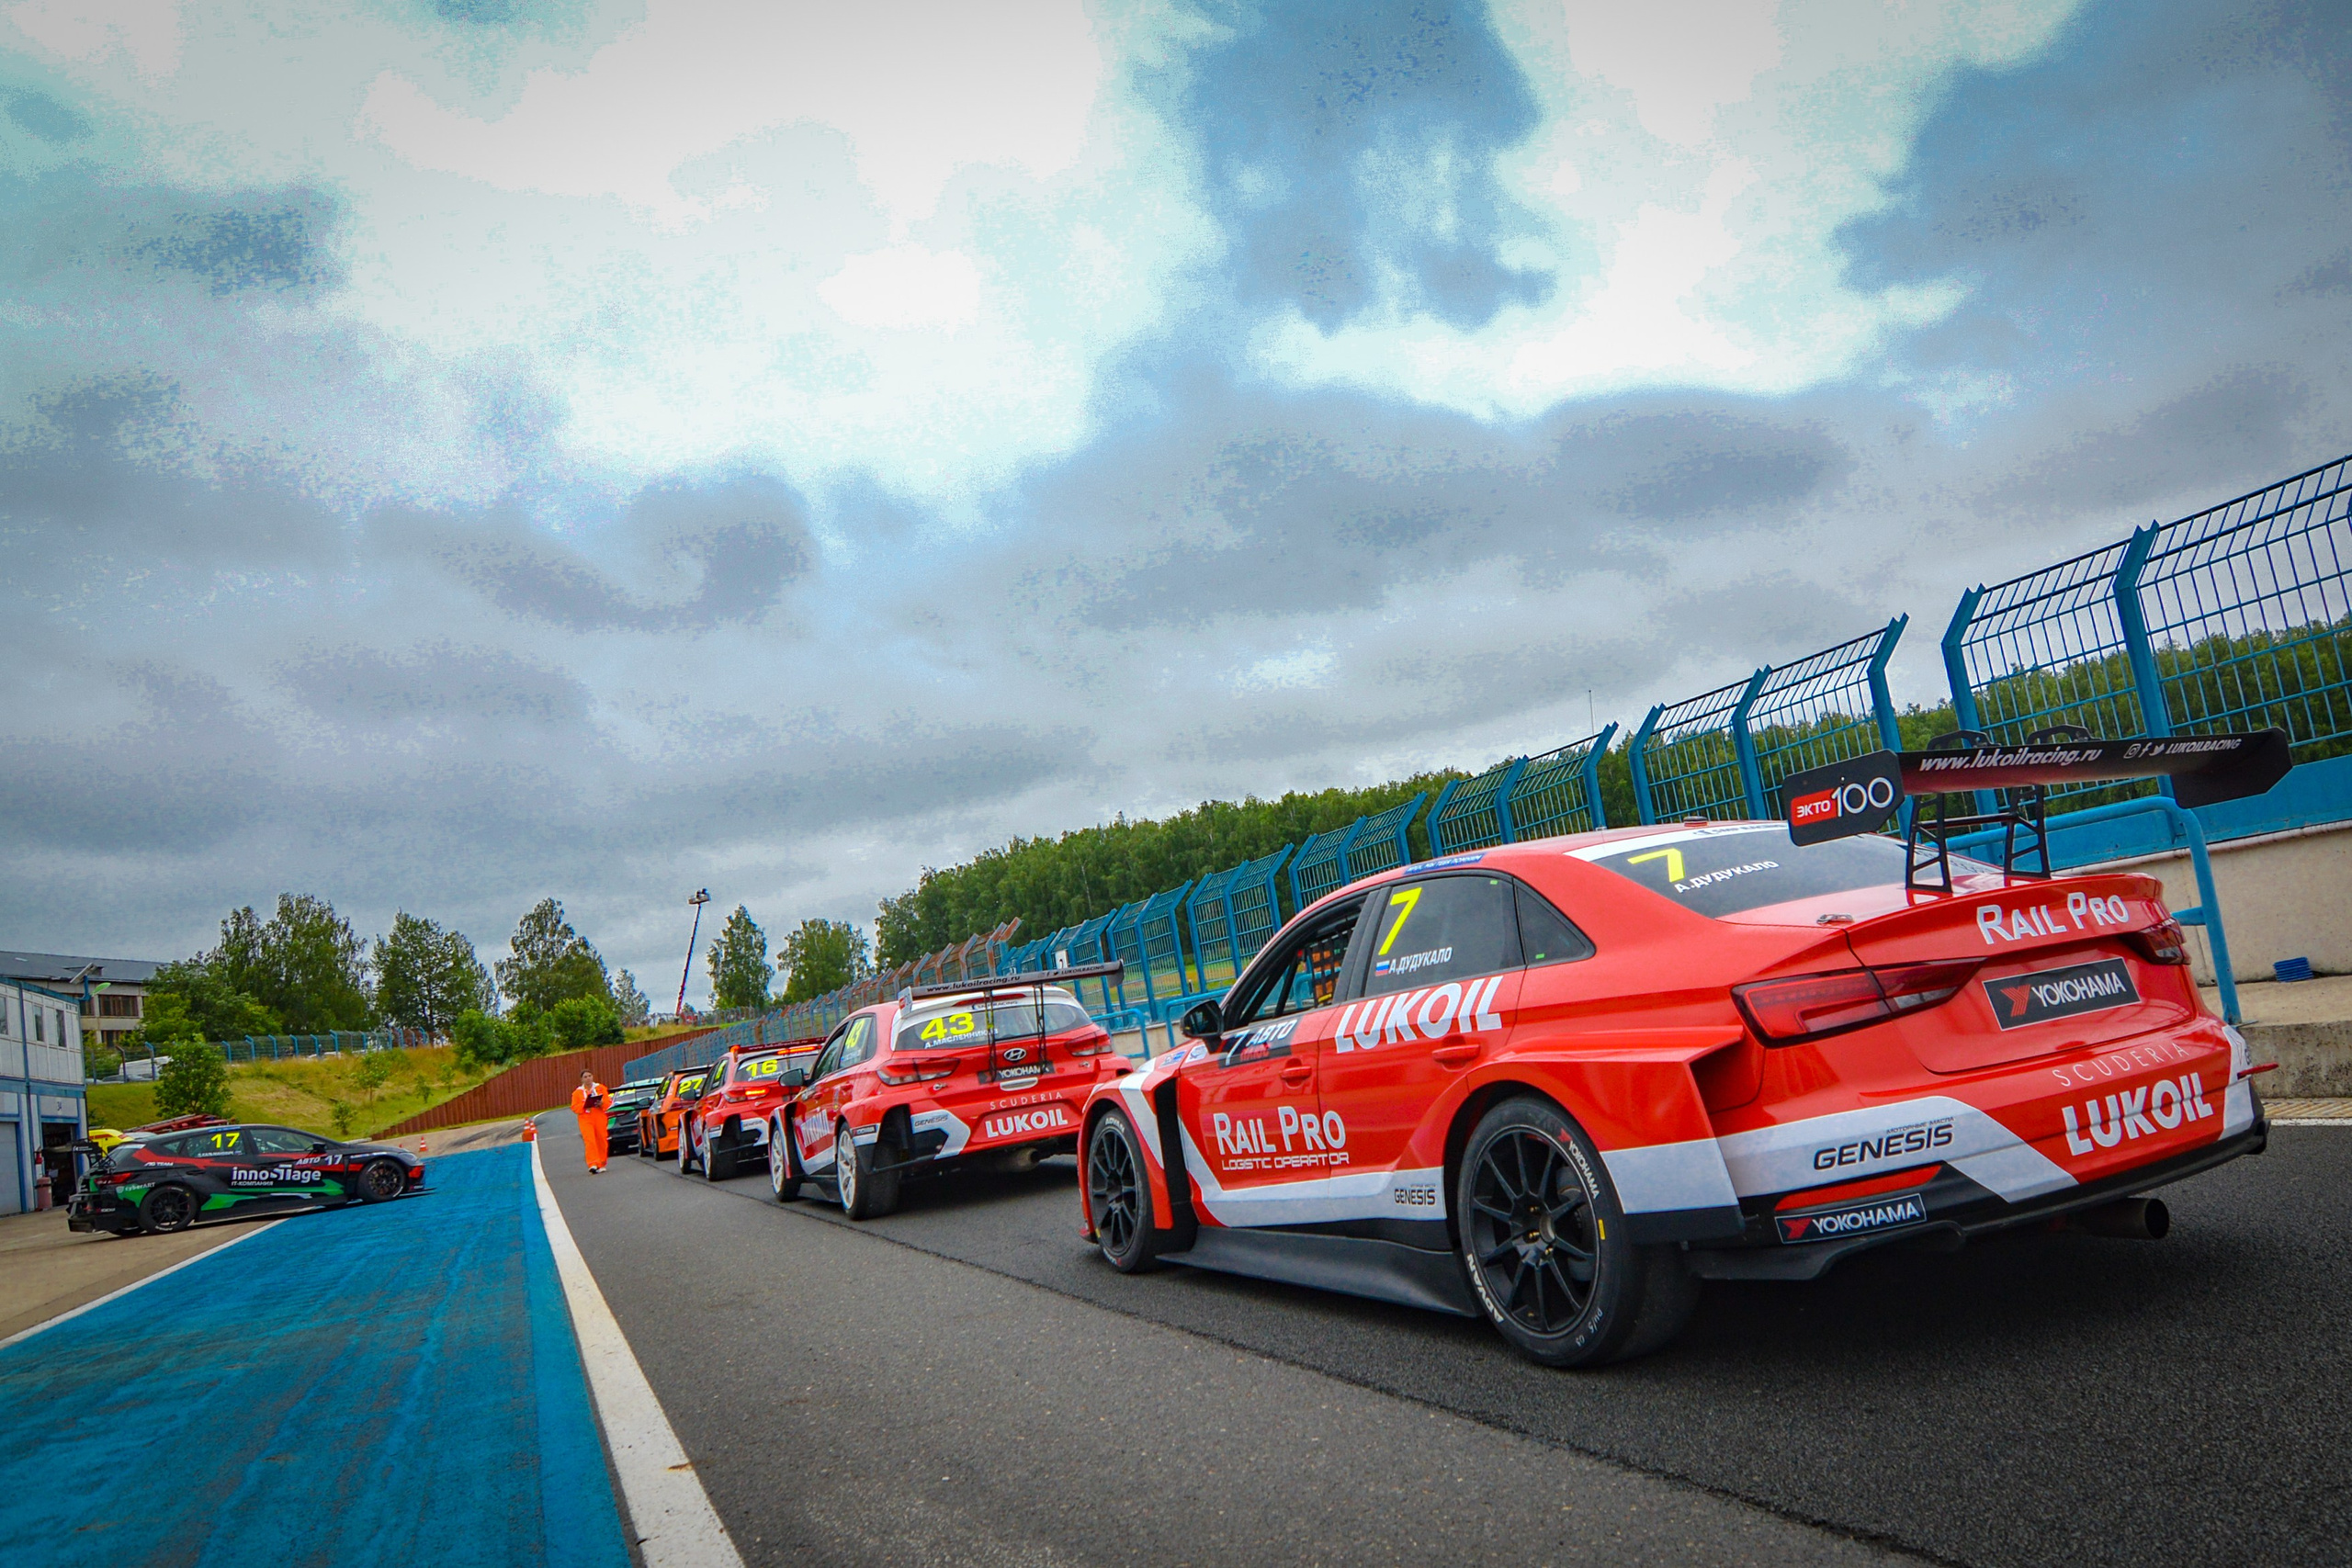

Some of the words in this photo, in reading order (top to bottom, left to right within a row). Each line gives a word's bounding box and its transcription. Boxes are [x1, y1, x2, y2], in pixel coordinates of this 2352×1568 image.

[1919, 746, 2102, 772] www.lukoilracing.ru
[2165, 739, 2243, 754] LUKOILRACING
[1796, 800, 1831, 818] ЭКТО
[1831, 777, 1894, 818] 100
[1627, 848, 1685, 883] 7
[1674, 861, 1780, 894] А.ДУДУКАЛО
[1378, 886, 1422, 955] 7
[1389, 947, 1453, 975] А.ДУДУКАЛО
[926, 976, 1021, 992] www.lukoilracing.ru
[2031, 972, 2127, 1007] YOKOHAMA
[921, 1012, 975, 1041] 43
[1335, 976, 1504, 1054] LUKOIL
[845, 1018, 865, 1049] 43
[1246, 1020, 1298, 1046] АВТО
[1226, 1030, 1250, 1066] 7
[745, 1059, 778, 1077] 16
[2052, 1043, 2190, 1087] SCUDERIA
[679, 1077, 703, 1094] 27
[989, 1091, 1063, 1111] SCUDERIA
[2062, 1072, 2214, 1156] LUKOIL
[914, 1113, 948, 1127] GENESIS
[985, 1109, 1069, 1139] LUKOIL
[210, 1132, 241, 1148] 17
[1814, 1123, 1954, 1170] GENESIS
[324, 1154, 344, 1166] 17
[1222, 1158, 1272, 1170] LOGISTIC
[1274, 1152, 1350, 1168] OPERATOR
[1568, 1140, 1600, 1199] YOKOHAMA
[125, 1181, 156, 1192] cyberART
[1394, 1189, 1436, 1205] GENESIS
[1812, 1201, 1921, 1235] YOKOHAMA
[1466, 1254, 1504, 1323] ADVAN
